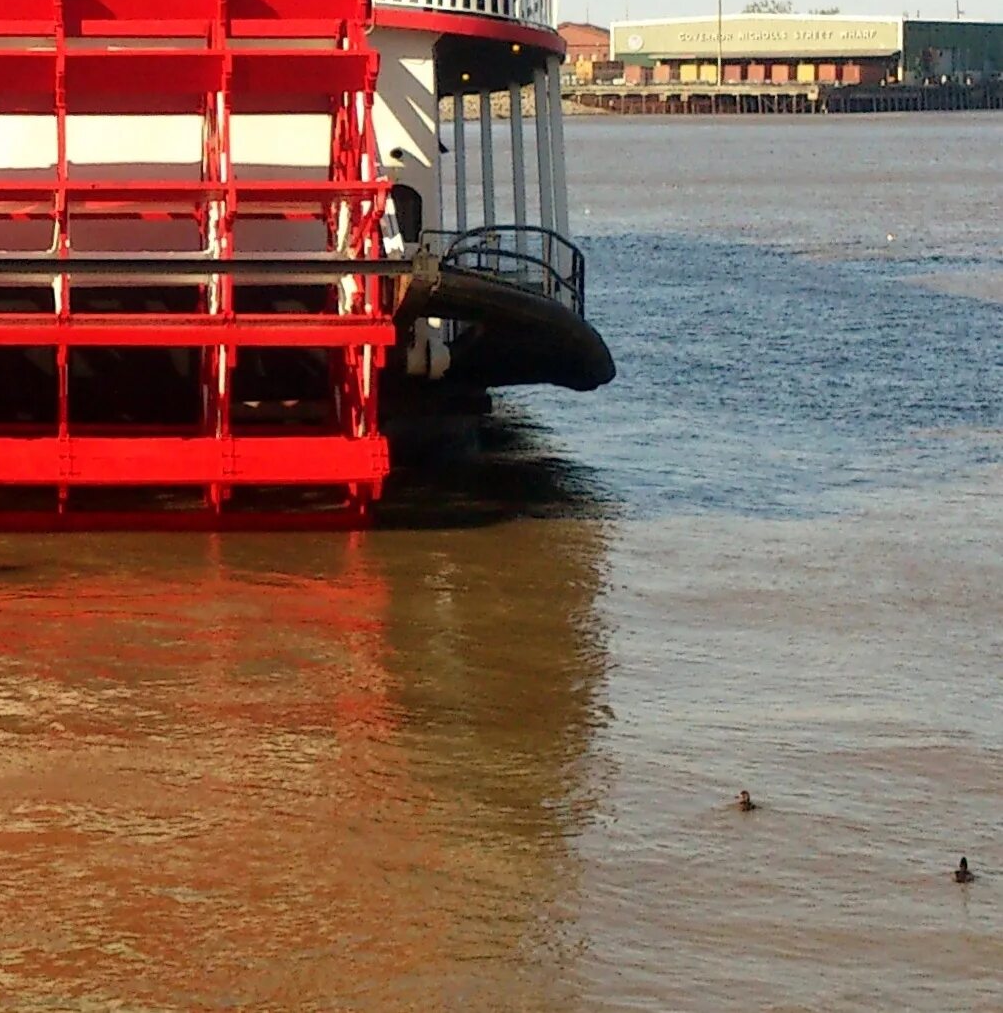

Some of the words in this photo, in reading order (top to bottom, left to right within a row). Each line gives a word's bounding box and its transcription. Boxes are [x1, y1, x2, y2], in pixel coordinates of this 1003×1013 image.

[678, 32, 733, 43] GOVERNOR
[794, 30, 834, 40] STREET
[840, 30, 878, 40] WHARF
